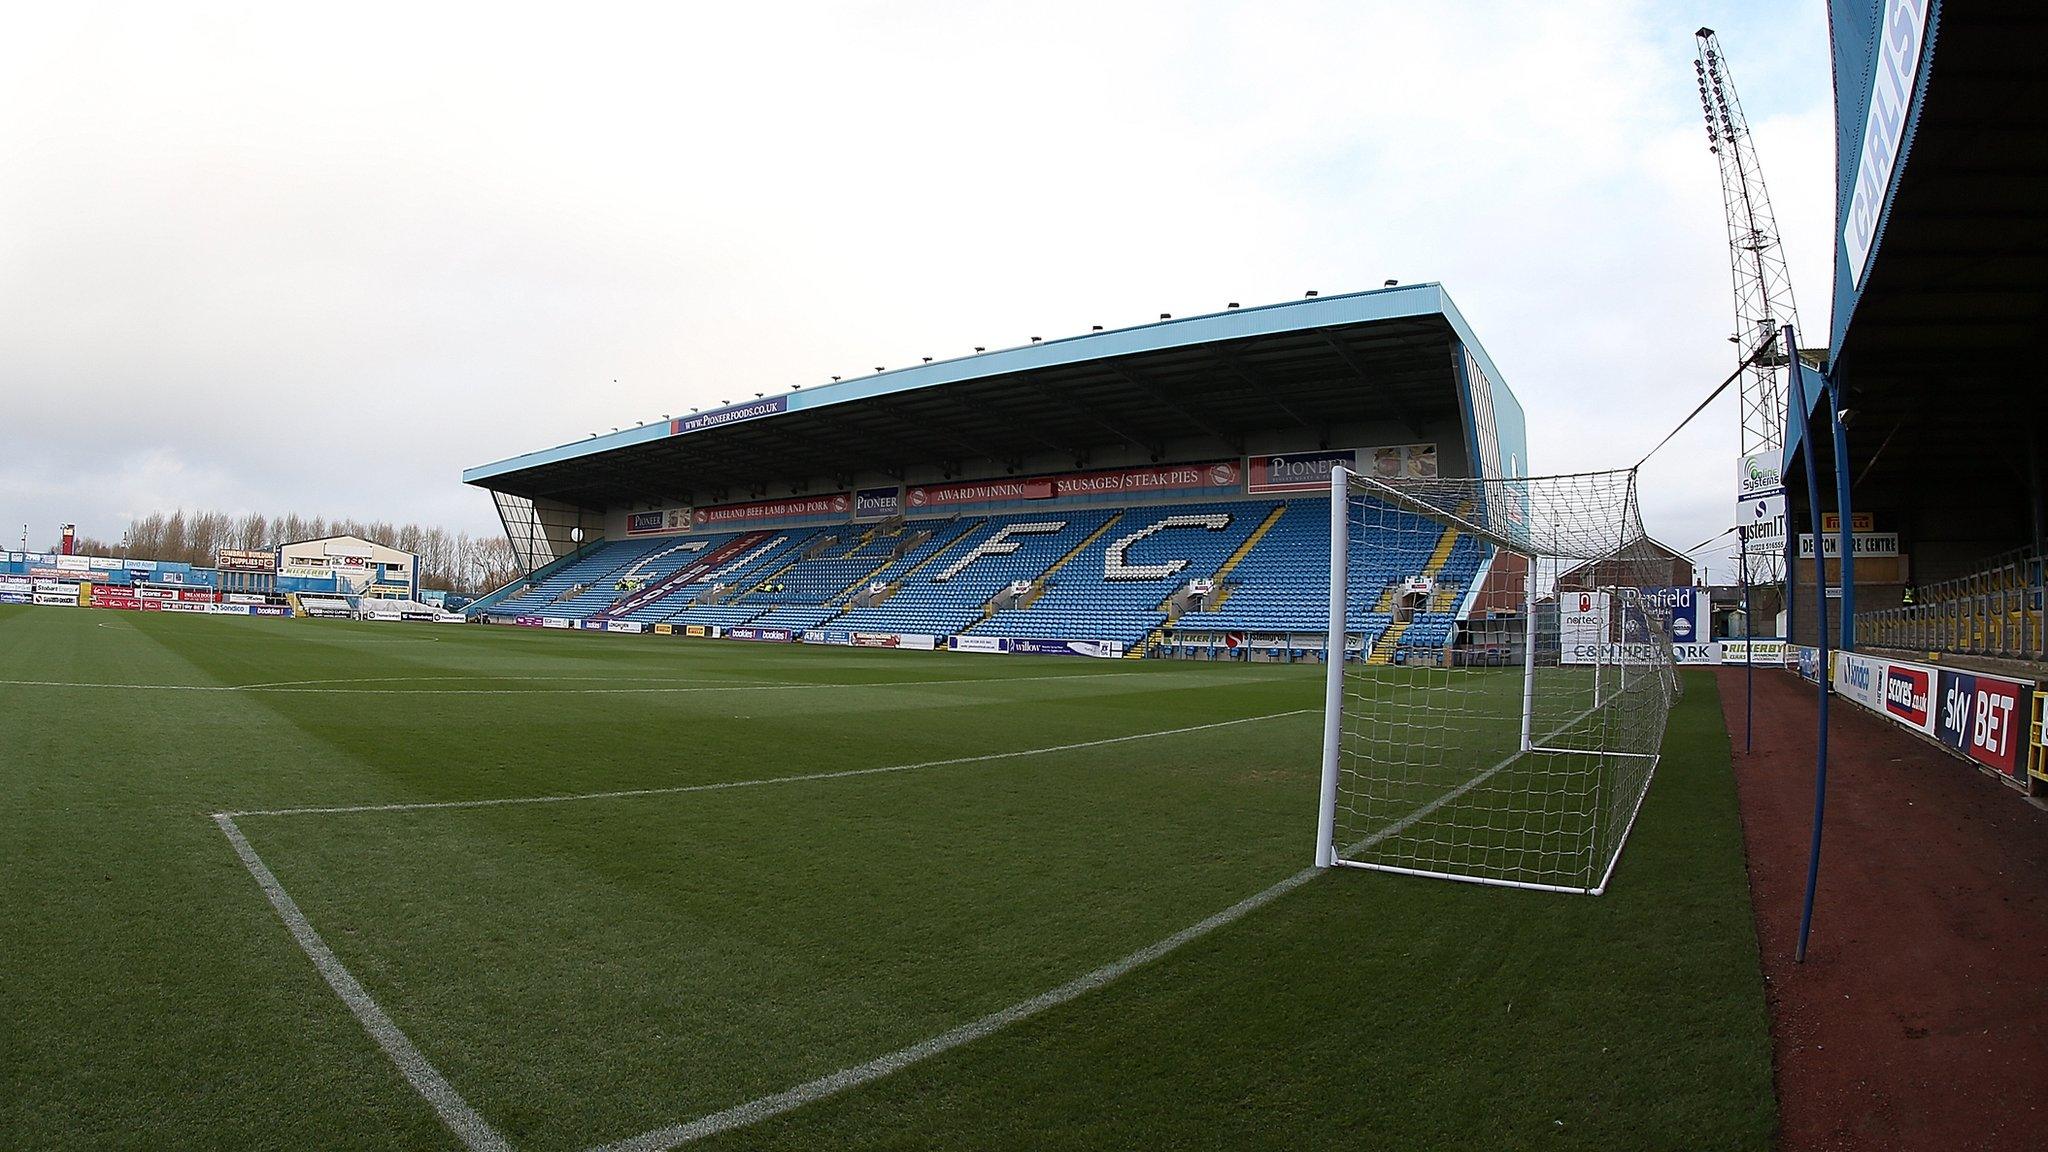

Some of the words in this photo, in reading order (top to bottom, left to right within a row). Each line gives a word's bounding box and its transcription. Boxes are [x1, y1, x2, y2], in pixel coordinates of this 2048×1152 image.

[1854, 0, 1926, 250] CARLIS
[1057, 472, 1167, 492] SAUSAGES/STEAK
[1171, 470, 1198, 484] PIES
[1743, 476, 1780, 491] Systems
[937, 487, 975, 501] AWARD
[857, 496, 897, 509] PIONEER
[710, 508, 745, 520] LAKELAND
[747, 506, 763, 516] BEEF
[765, 504, 785, 515] LAMB
[787, 502, 804, 513] AND
[807, 501, 829, 512] PORK
[635, 514, 661, 527] PIONEER
[935, 521, 1068, 582] F
[1104, 514, 1232, 580] C
[1865, 537, 1896, 552] CENTRE
[220, 550, 246, 558] CUMBRIA
[231, 557, 258, 566] SUPPLIES
[58, 586, 74, 594] Energy
[220, 603, 245, 612] Sondico
[1173, 633, 1224, 643] RCKERBY
[1015, 641, 1041, 652] willow
[1945, 676, 1972, 748] sky
[1973, 690, 2014, 757] BET
